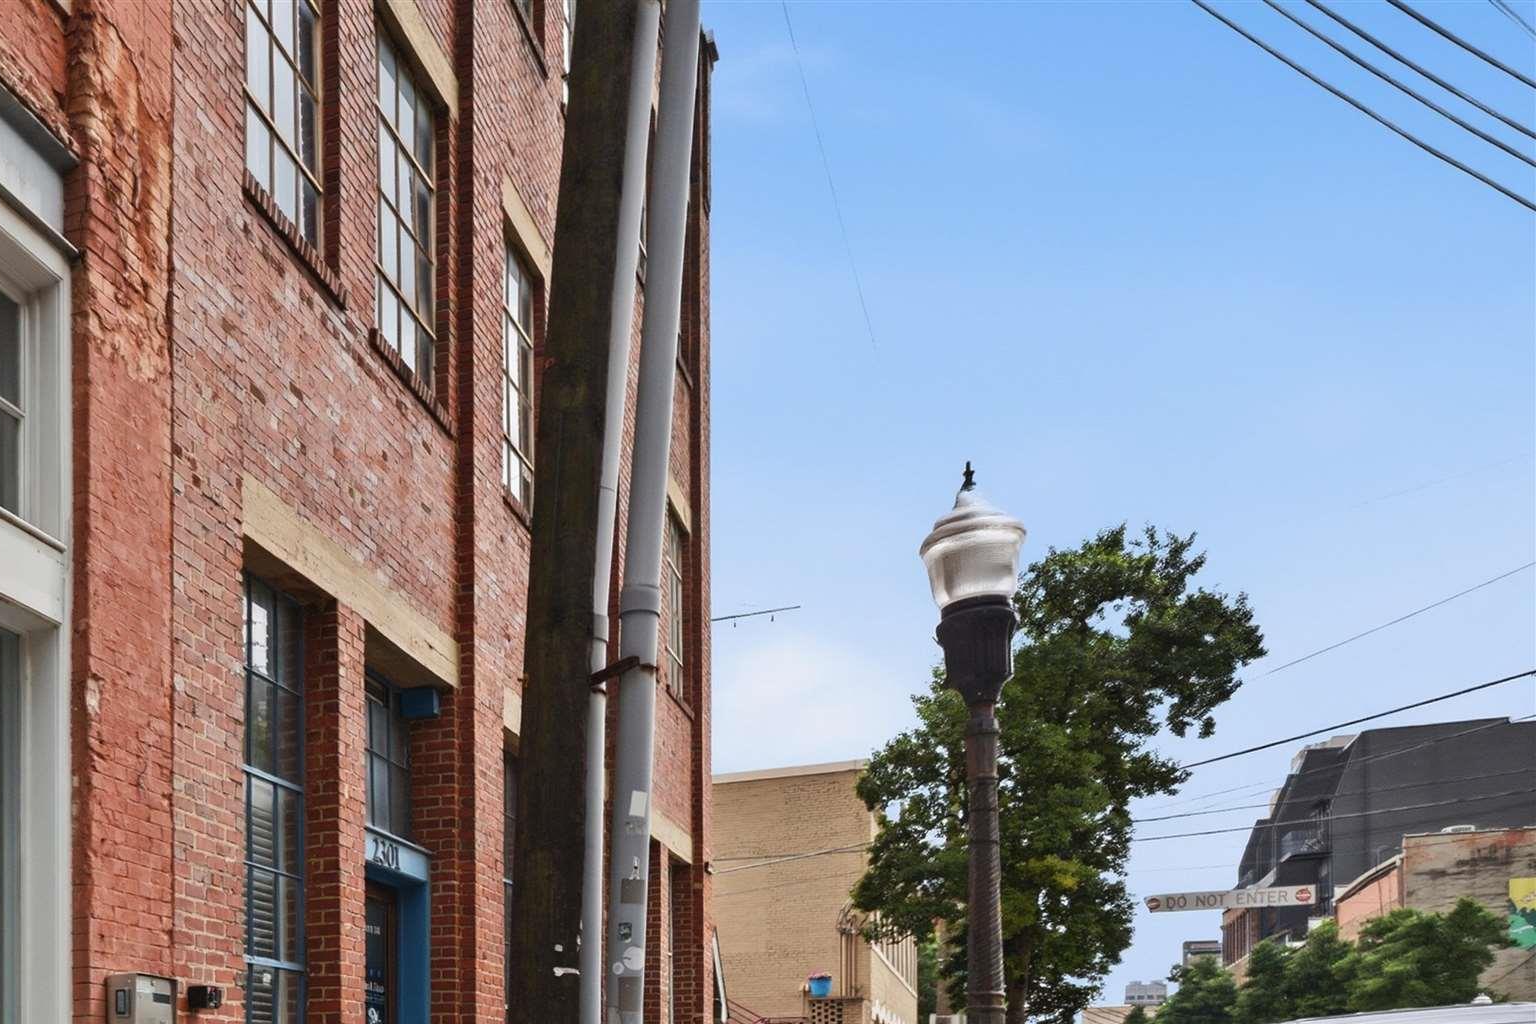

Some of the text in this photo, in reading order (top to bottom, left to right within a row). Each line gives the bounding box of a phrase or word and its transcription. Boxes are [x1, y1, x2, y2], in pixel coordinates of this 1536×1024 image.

[372, 838, 401, 871] 2301
[1166, 890, 1288, 908] DO NOT ENTER
